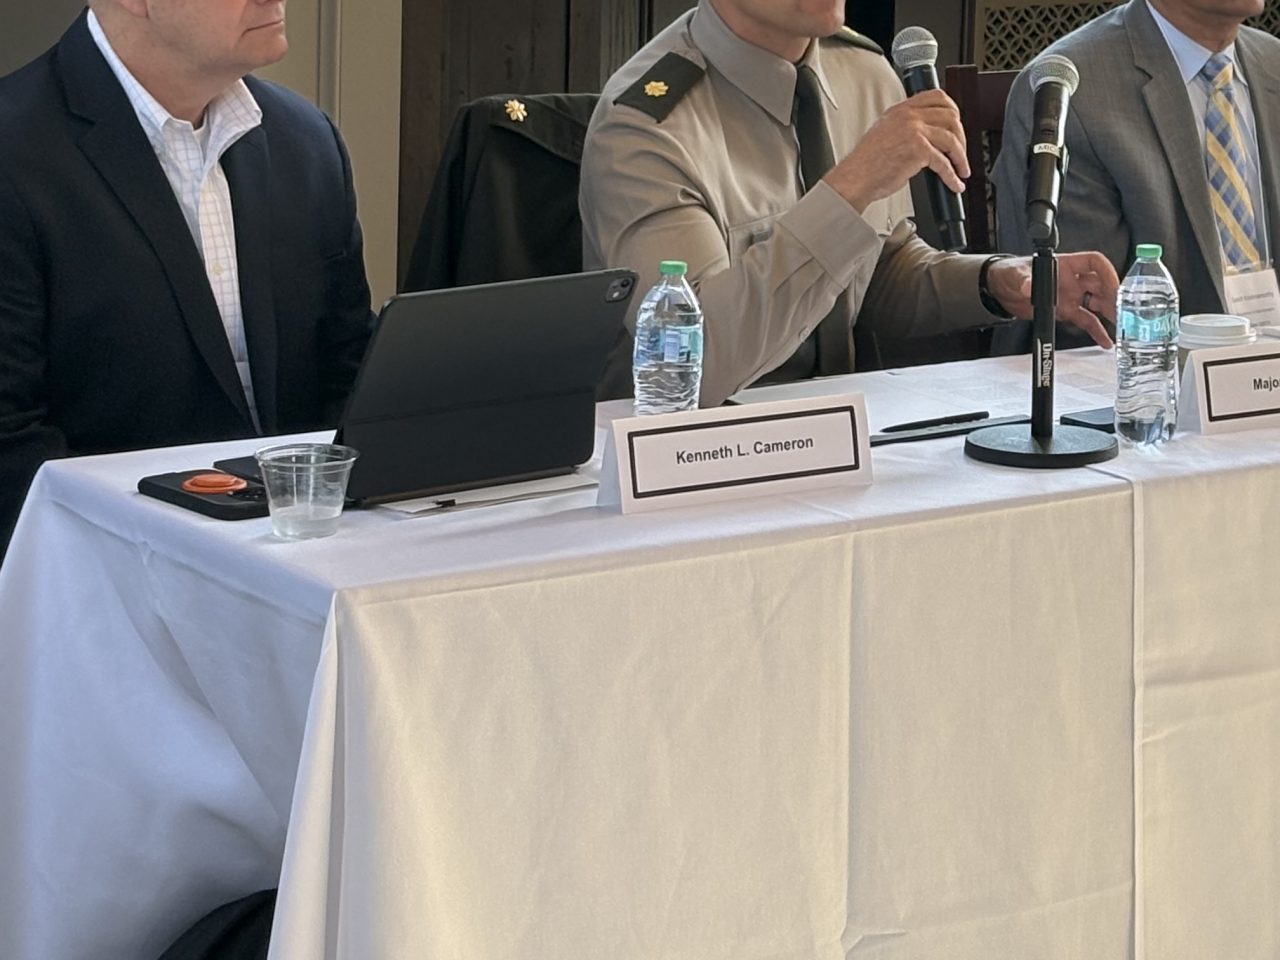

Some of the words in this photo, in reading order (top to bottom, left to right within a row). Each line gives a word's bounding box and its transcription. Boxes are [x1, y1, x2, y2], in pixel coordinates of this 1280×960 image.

[676, 445, 733, 465] Kenneth
[736, 443, 750, 457] L.
[753, 437, 814, 454] Cameron
